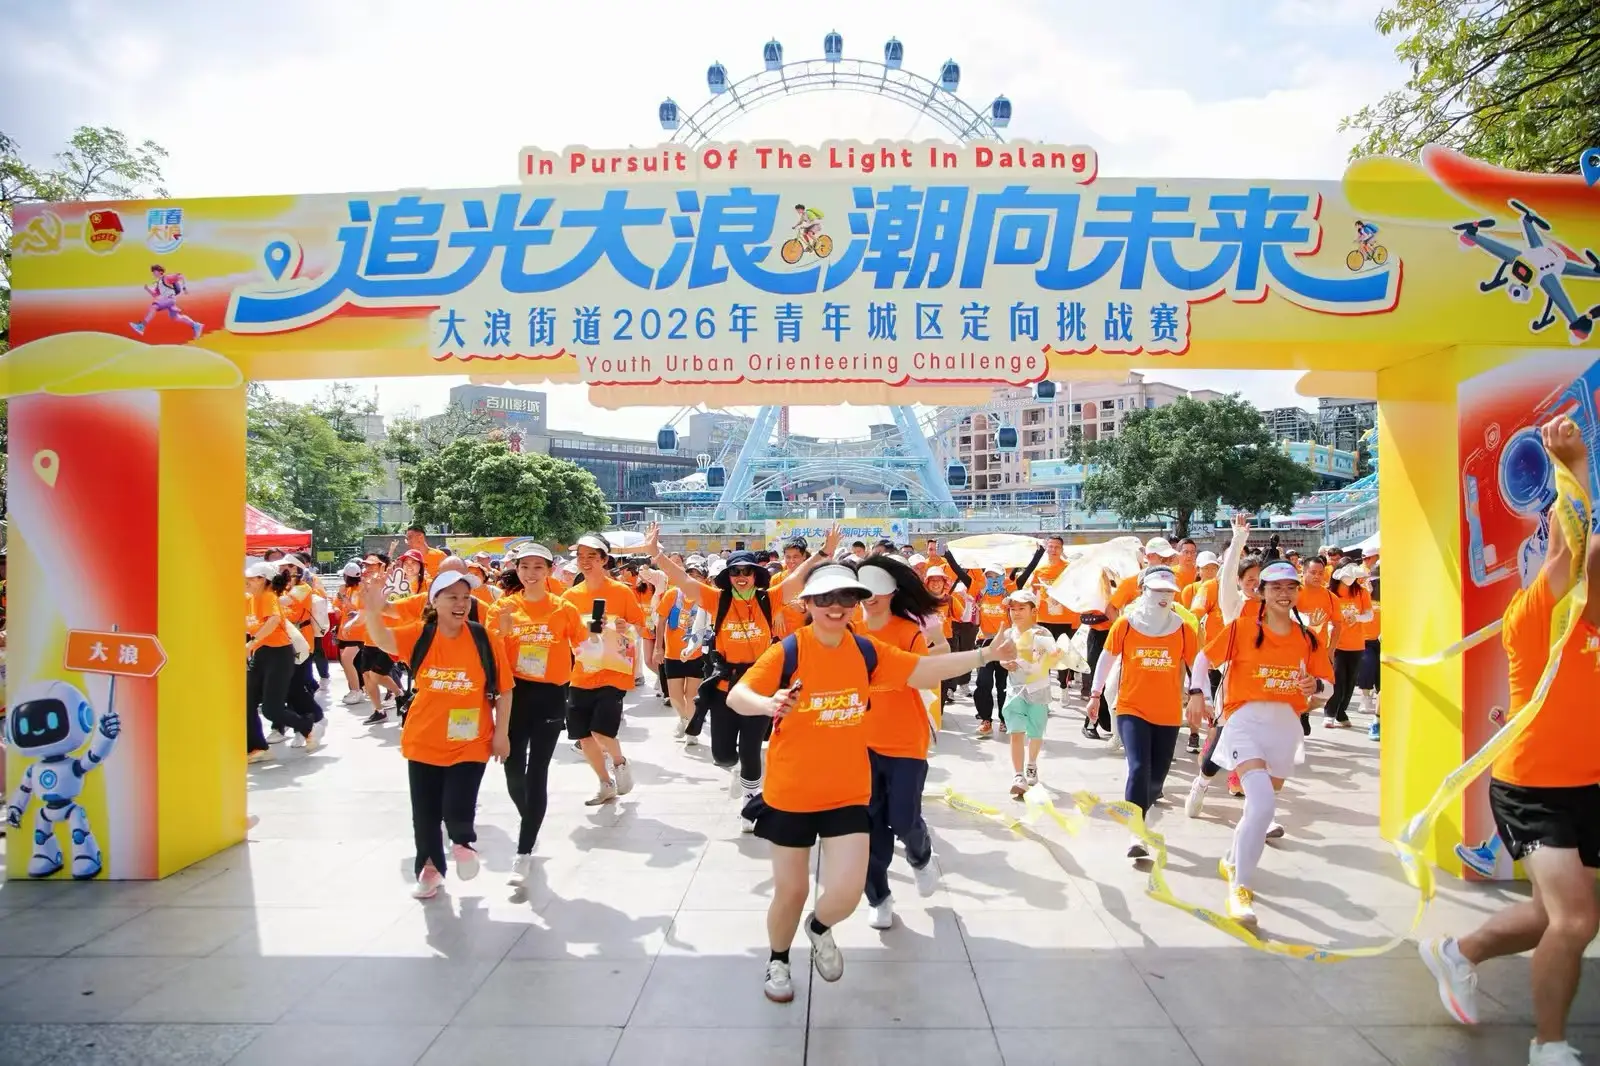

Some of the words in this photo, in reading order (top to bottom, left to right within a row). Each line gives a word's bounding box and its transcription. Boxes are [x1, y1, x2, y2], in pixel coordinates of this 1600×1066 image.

[526, 154, 554, 175] In
[569, 151, 687, 174] Pursuit
[702, 148, 738, 169] Of
[755, 147, 813, 169] The
[829, 146, 912, 173] Light
[929, 146, 957, 169] In
[975, 145, 1087, 173] Dalang
[438, 301, 1179, 349] 大浪街道2026年青年城区定向挑战赛
[586, 355, 651, 373] Youth
[665, 354, 734, 372] Urban
[748, 353, 899, 373] Orienteering
[913, 352, 1037, 373] Challenge
[486, 396, 541, 412] 百川影城
[88, 641, 139, 665] 大浪
[798, 693, 863, 712] 追光大浪
